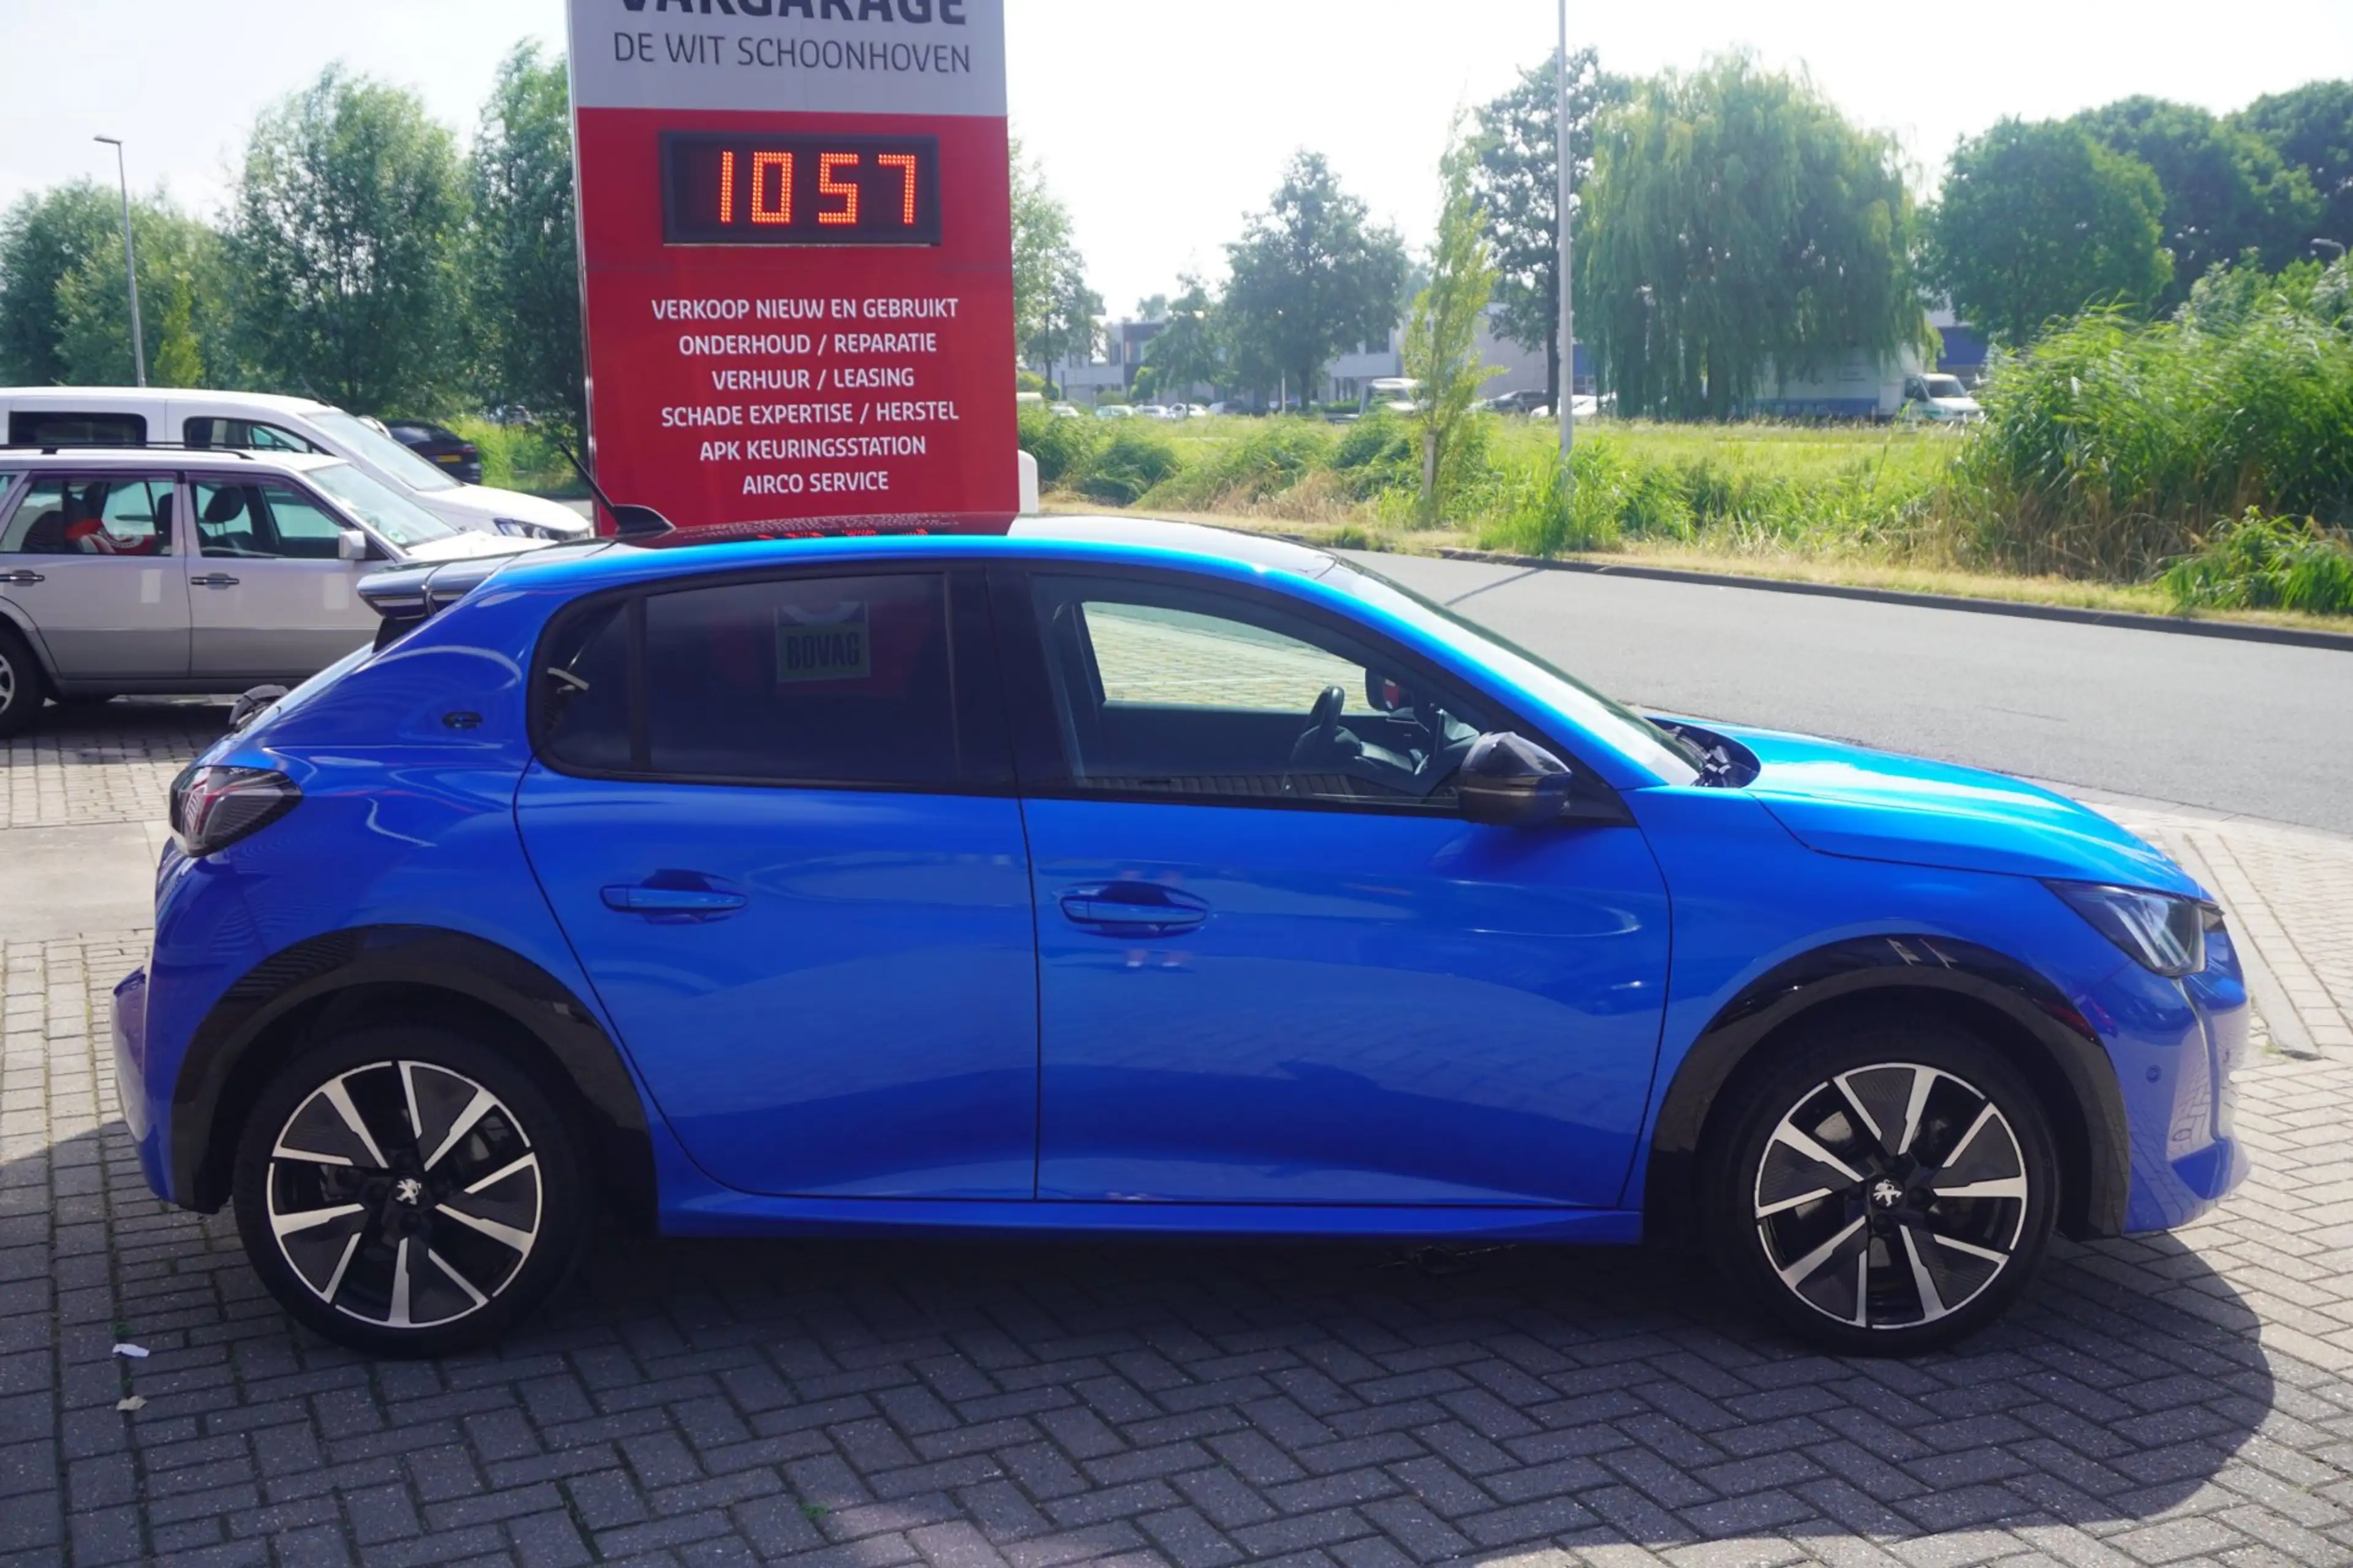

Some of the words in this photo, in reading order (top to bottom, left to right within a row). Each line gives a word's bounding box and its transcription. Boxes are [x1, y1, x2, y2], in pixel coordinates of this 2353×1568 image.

[614, 32, 654, 62] DE
[665, 32, 726, 66] WIT
[737, 37, 970, 73] SCHOONHOVEN
[651, 299, 750, 320] VERKOOP
[756, 298, 825, 319] NIEUW
[831, 299, 857, 318] EN
[863, 298, 959, 319] GEBRUIKT
[679, 334, 811, 356] ONDERHOUD
[817, 334, 828, 357] /
[834, 333, 937, 354] REPARATIE
[711, 369, 811, 391] VERHUUR
[817, 369, 827, 392] /
[834, 368, 915, 388] LEASING
[662, 406, 743, 428] SCHADE
[750, 403, 853, 425] EXPERTISE
[860, 403, 870, 425] /
[877, 401, 960, 422] HERSTEL
[700, 441, 741, 462] APK
[747, 436, 926, 460] KEURINGSSTATION
[743, 474, 804, 495] AIRCO
[810, 471, 890, 493] SERVICE
[787, 631, 860, 670] BOVAG
